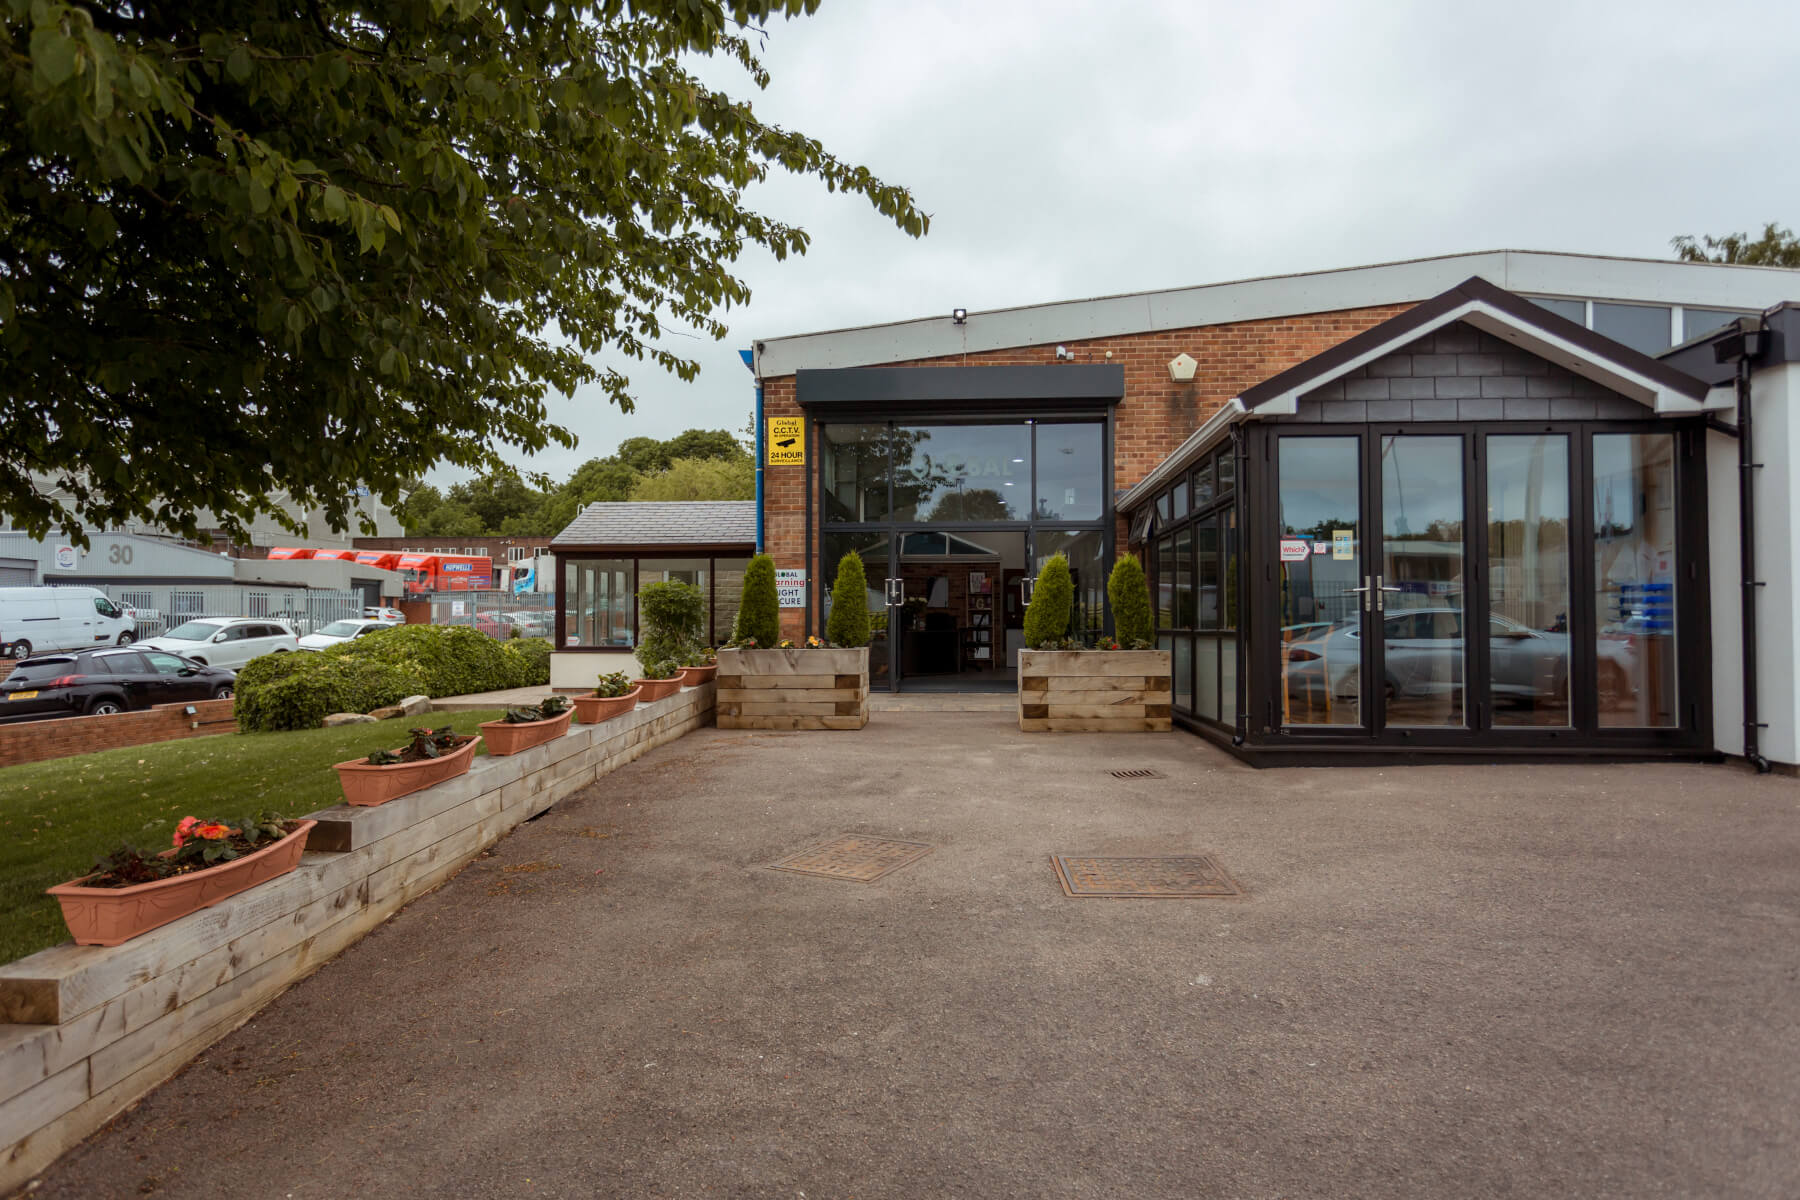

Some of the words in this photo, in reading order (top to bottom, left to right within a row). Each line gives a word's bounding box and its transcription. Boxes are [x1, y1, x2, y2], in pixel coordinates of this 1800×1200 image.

[781, 451, 803, 459] HOUR
[109, 543, 133, 565] 30
[776, 578, 805, 587] arning
